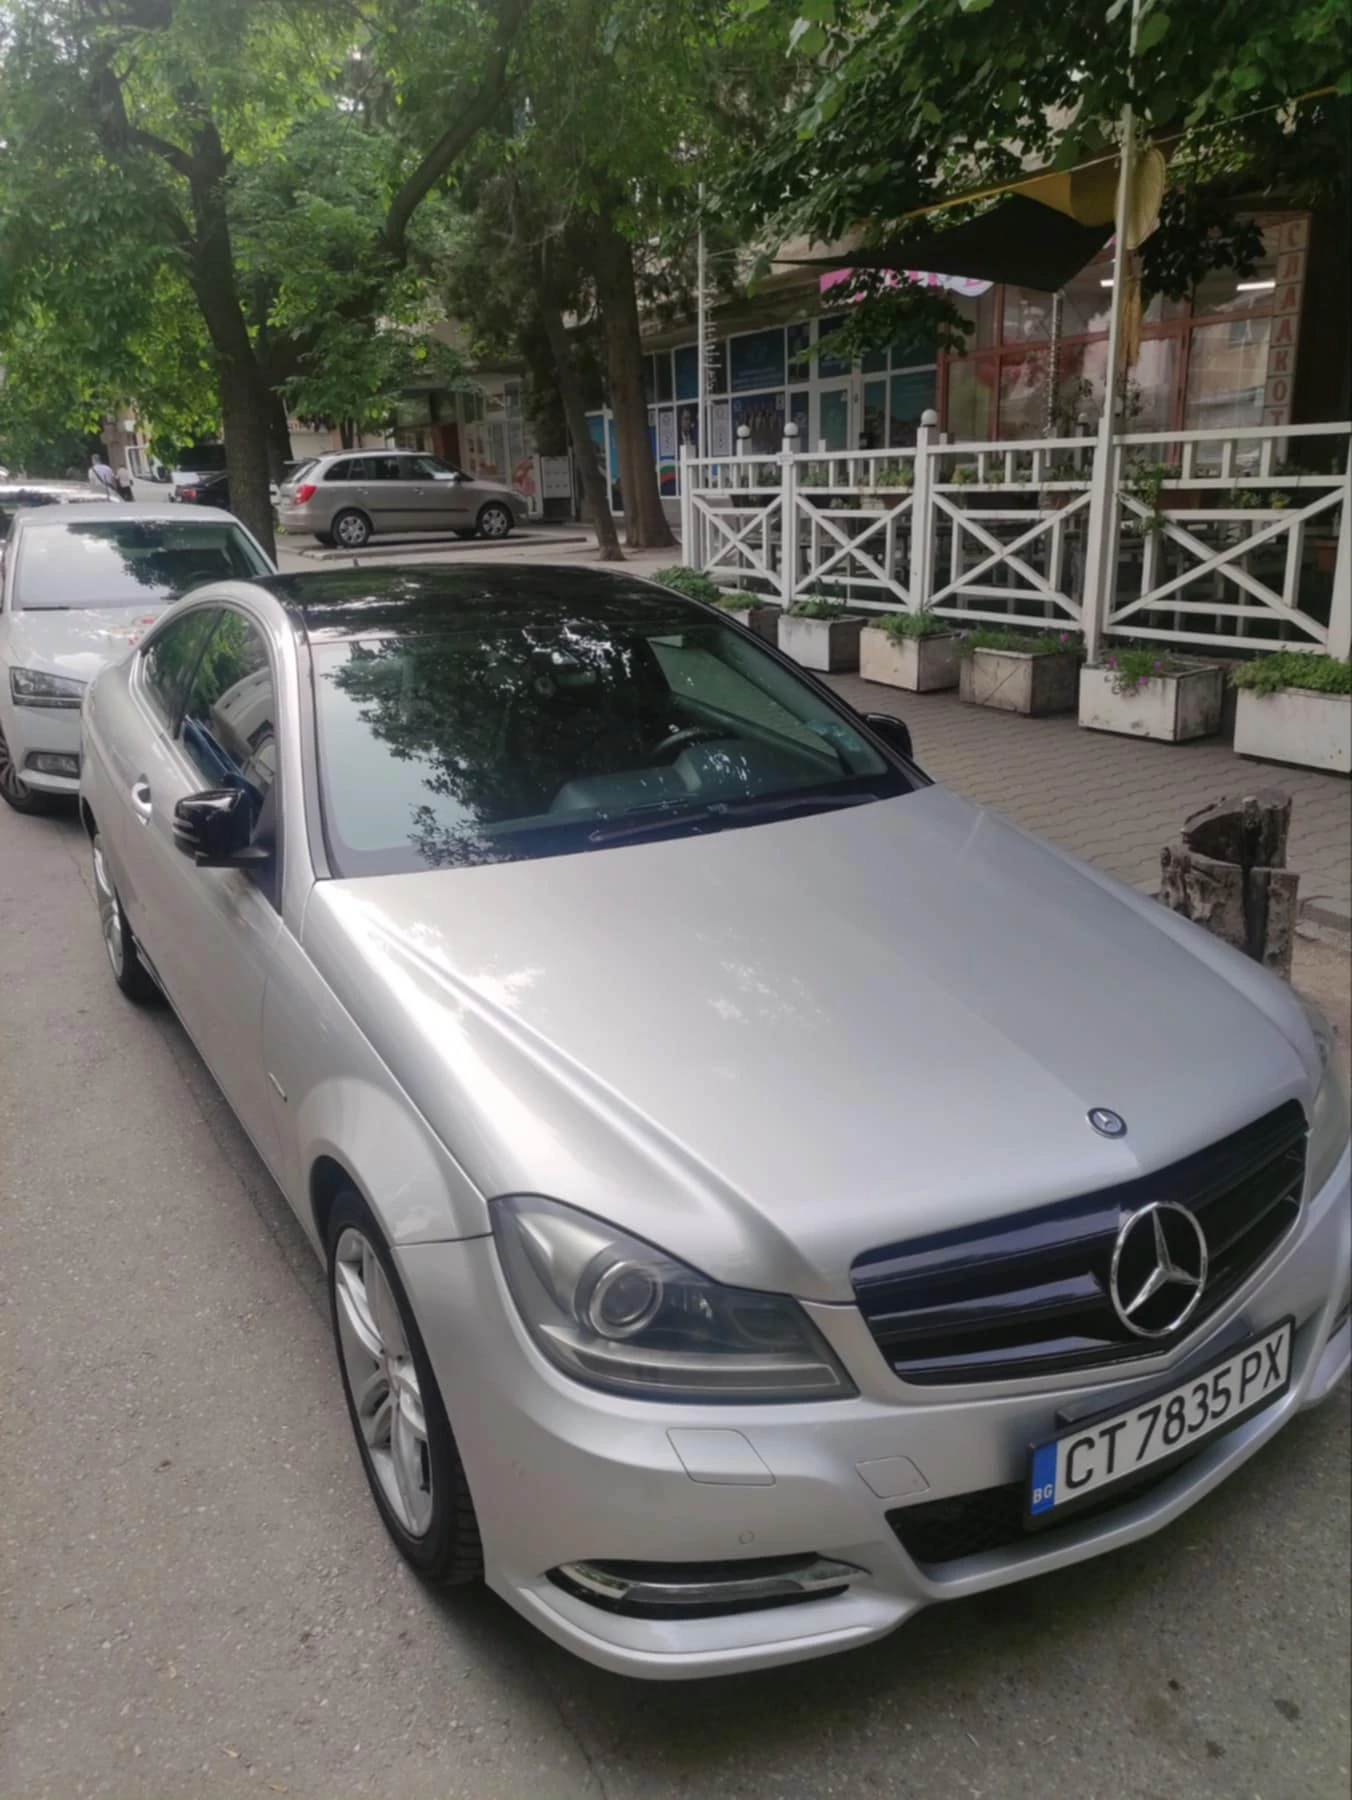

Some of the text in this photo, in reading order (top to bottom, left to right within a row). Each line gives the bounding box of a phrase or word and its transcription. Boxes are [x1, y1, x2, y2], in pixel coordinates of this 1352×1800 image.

[1065, 1334, 1283, 1489] CT 7835 PX
[1033, 1484, 1053, 1504] BG
